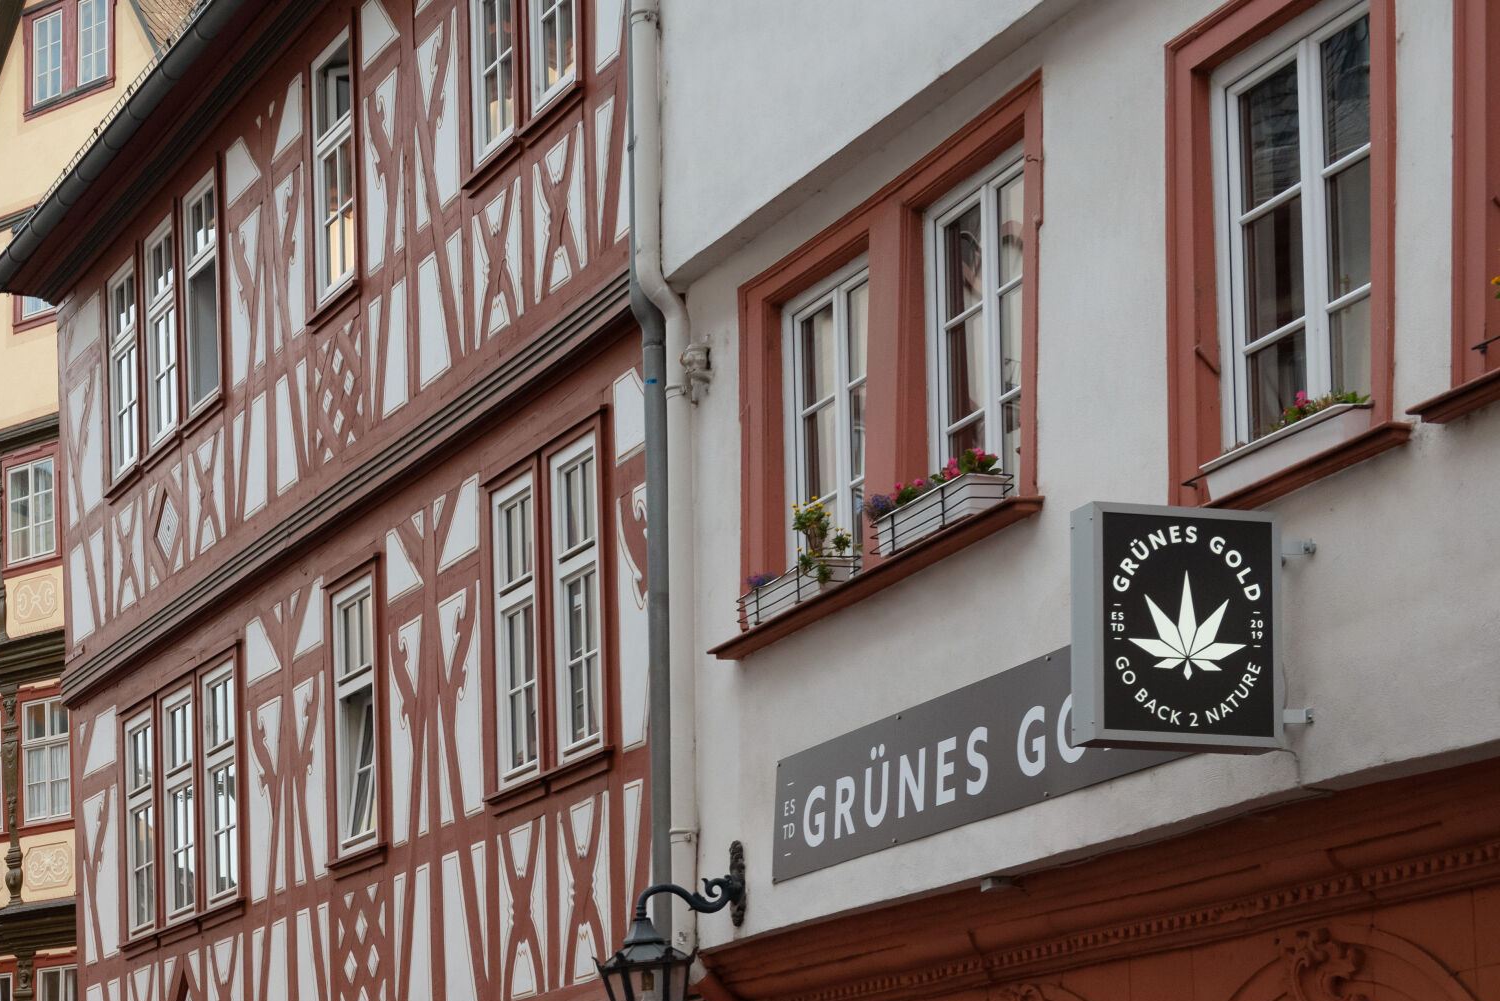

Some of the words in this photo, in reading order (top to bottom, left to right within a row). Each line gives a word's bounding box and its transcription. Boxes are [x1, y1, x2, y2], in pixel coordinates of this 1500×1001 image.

[1112, 525, 1198, 593] GRÜNES
[1208, 535, 1262, 602] GOLD
[1111, 611, 1124, 621] ES
[1250, 619, 1263, 629] 20
[1111, 622, 1125, 633] TD
[1251, 630, 1263, 640] 19
[1116, 656, 1136, 686] GO
[1134, 688, 1182, 727] BACK
[1188, 712, 1199, 727] 2
[1205, 661, 1262, 725] NATURE
[802, 726, 989, 848] GRÜNES
[1016, 692, 1100, 778] GO
[783, 798, 796, 816] ES
[782, 822, 796, 841] TD
